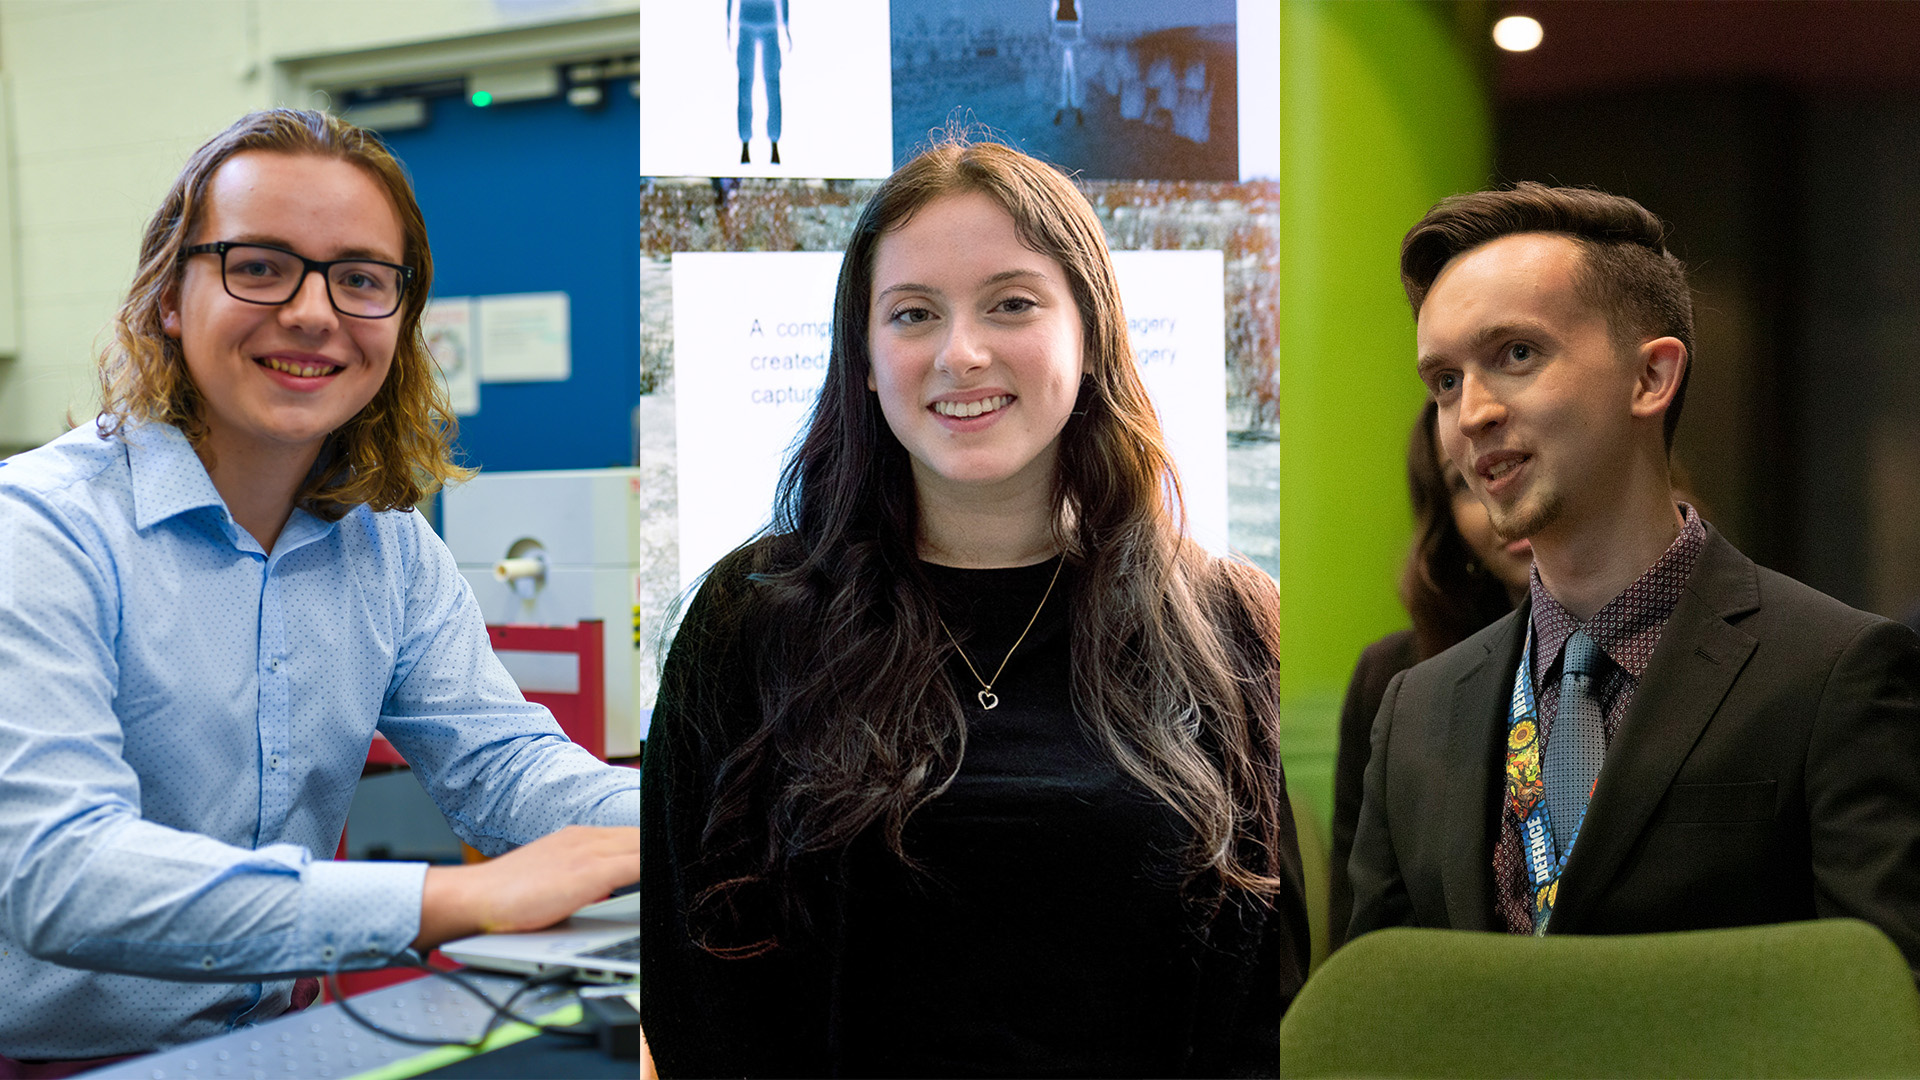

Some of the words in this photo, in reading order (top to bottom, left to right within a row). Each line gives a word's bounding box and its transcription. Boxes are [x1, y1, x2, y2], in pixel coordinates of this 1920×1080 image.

[750, 318, 764, 338] A
[776, 321, 831, 341] comp
[1129, 317, 1176, 336] agery
[750, 352, 826, 371] created
[1138, 347, 1176, 367] gery
[751, 386, 817, 407] captur
[1526, 816, 1549, 884] DEFENCE
